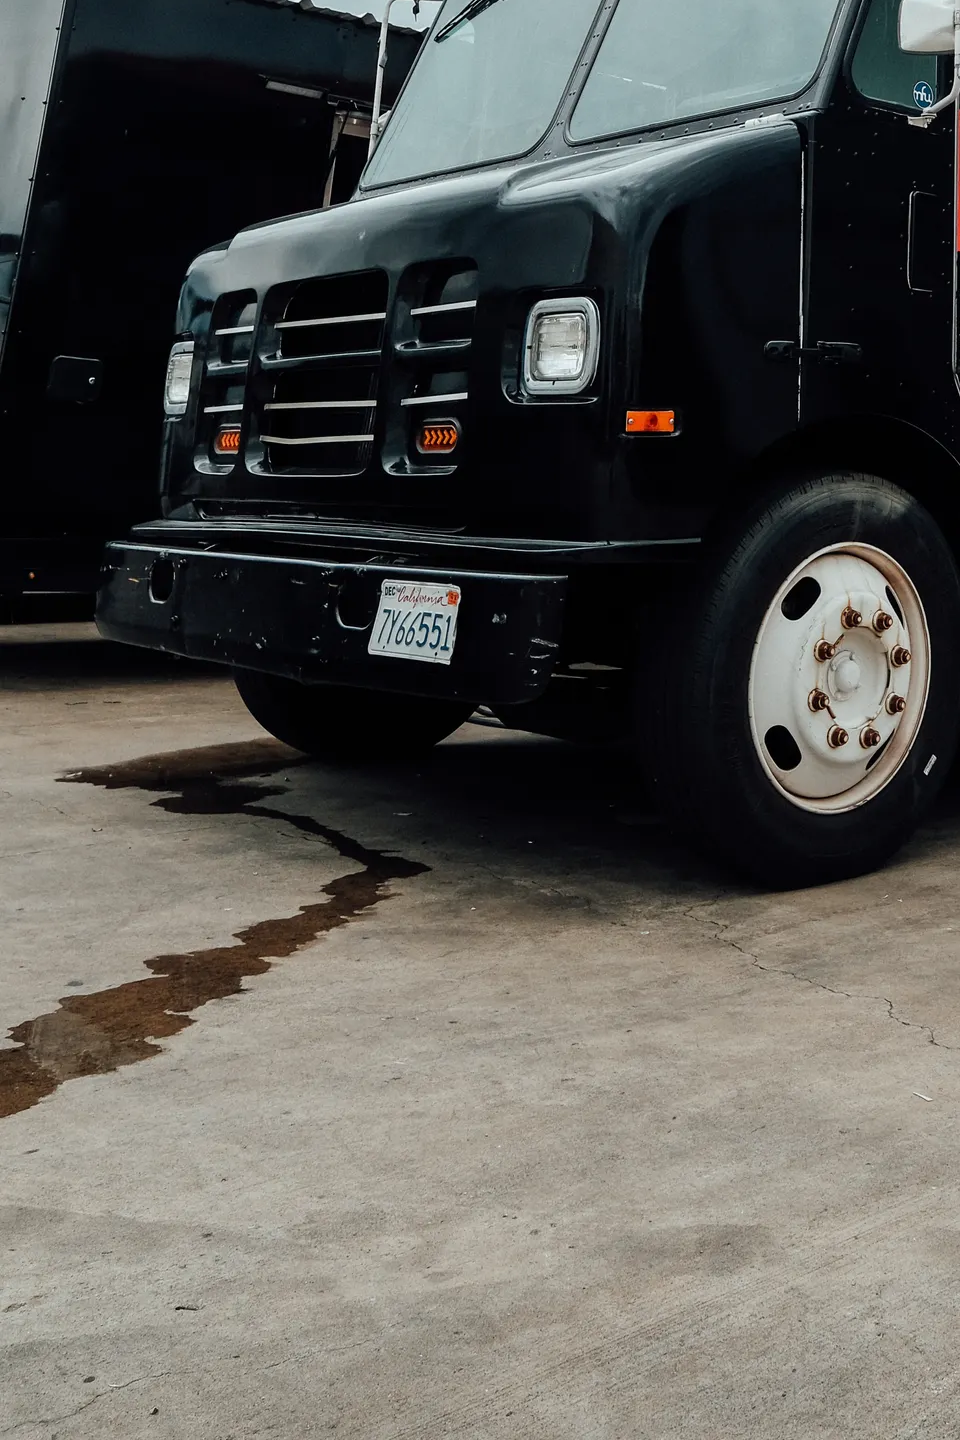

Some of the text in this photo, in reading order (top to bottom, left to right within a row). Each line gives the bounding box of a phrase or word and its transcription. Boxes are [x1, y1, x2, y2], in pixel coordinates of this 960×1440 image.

[384, 586, 396, 597] DEC
[397, 586, 447, 608] California
[378, 608, 452, 651] 7Y66551
